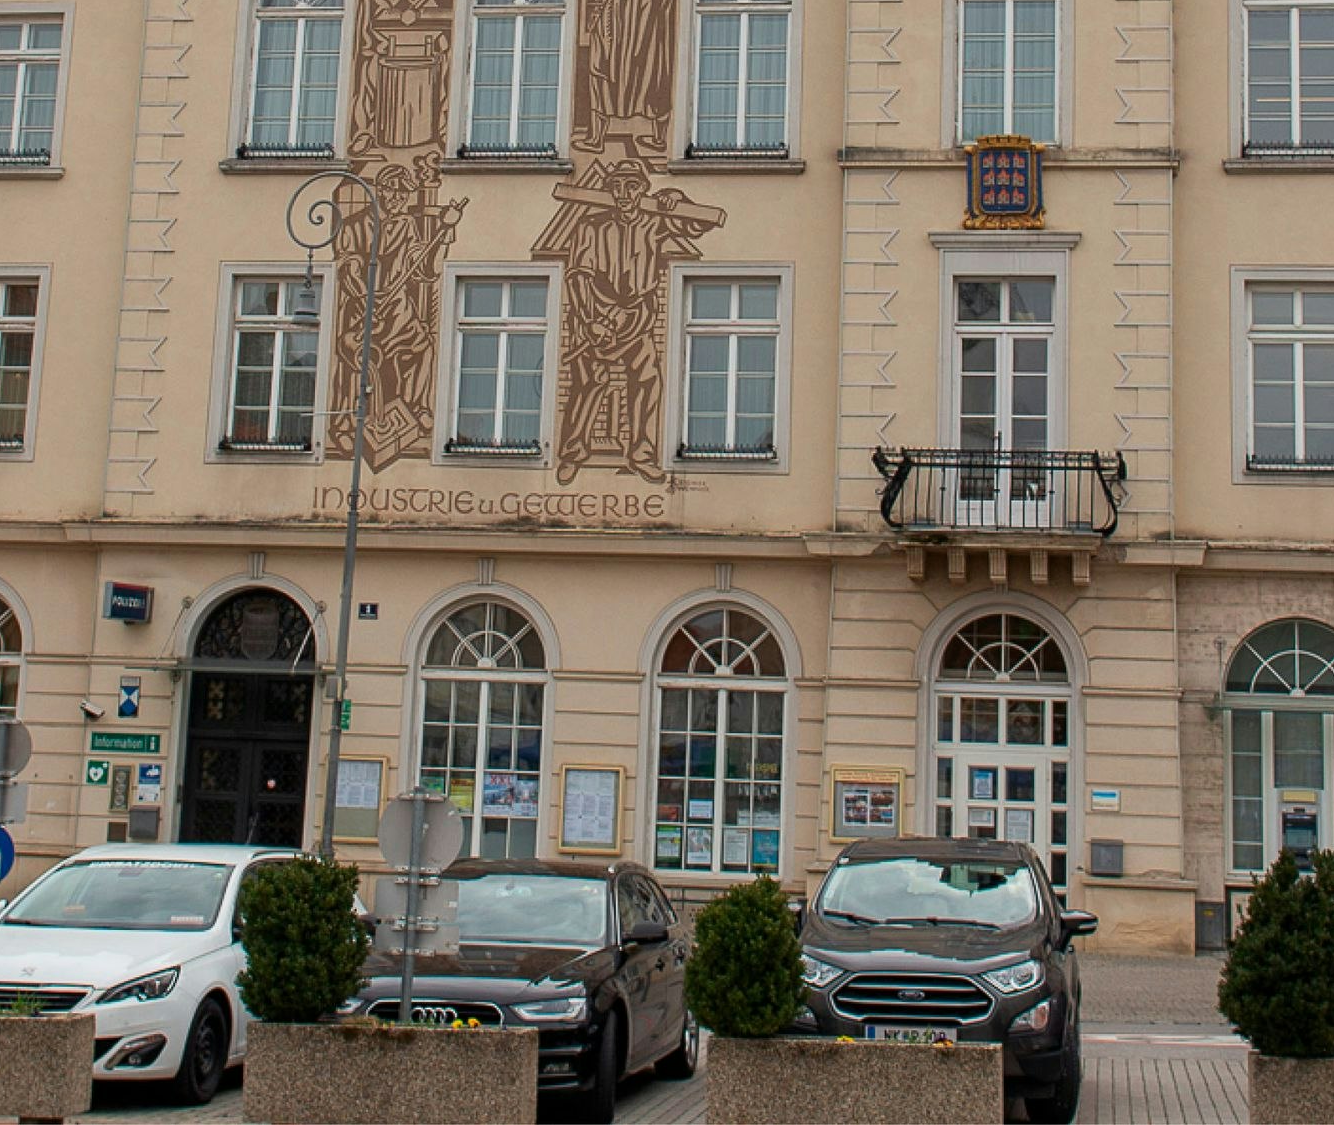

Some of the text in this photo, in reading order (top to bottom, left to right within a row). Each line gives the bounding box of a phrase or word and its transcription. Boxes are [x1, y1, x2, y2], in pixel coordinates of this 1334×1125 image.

[312, 485, 475, 516] INDUSTRIE
[500, 491, 665, 520] GEWERBE
[94, 734, 144, 749] Information
